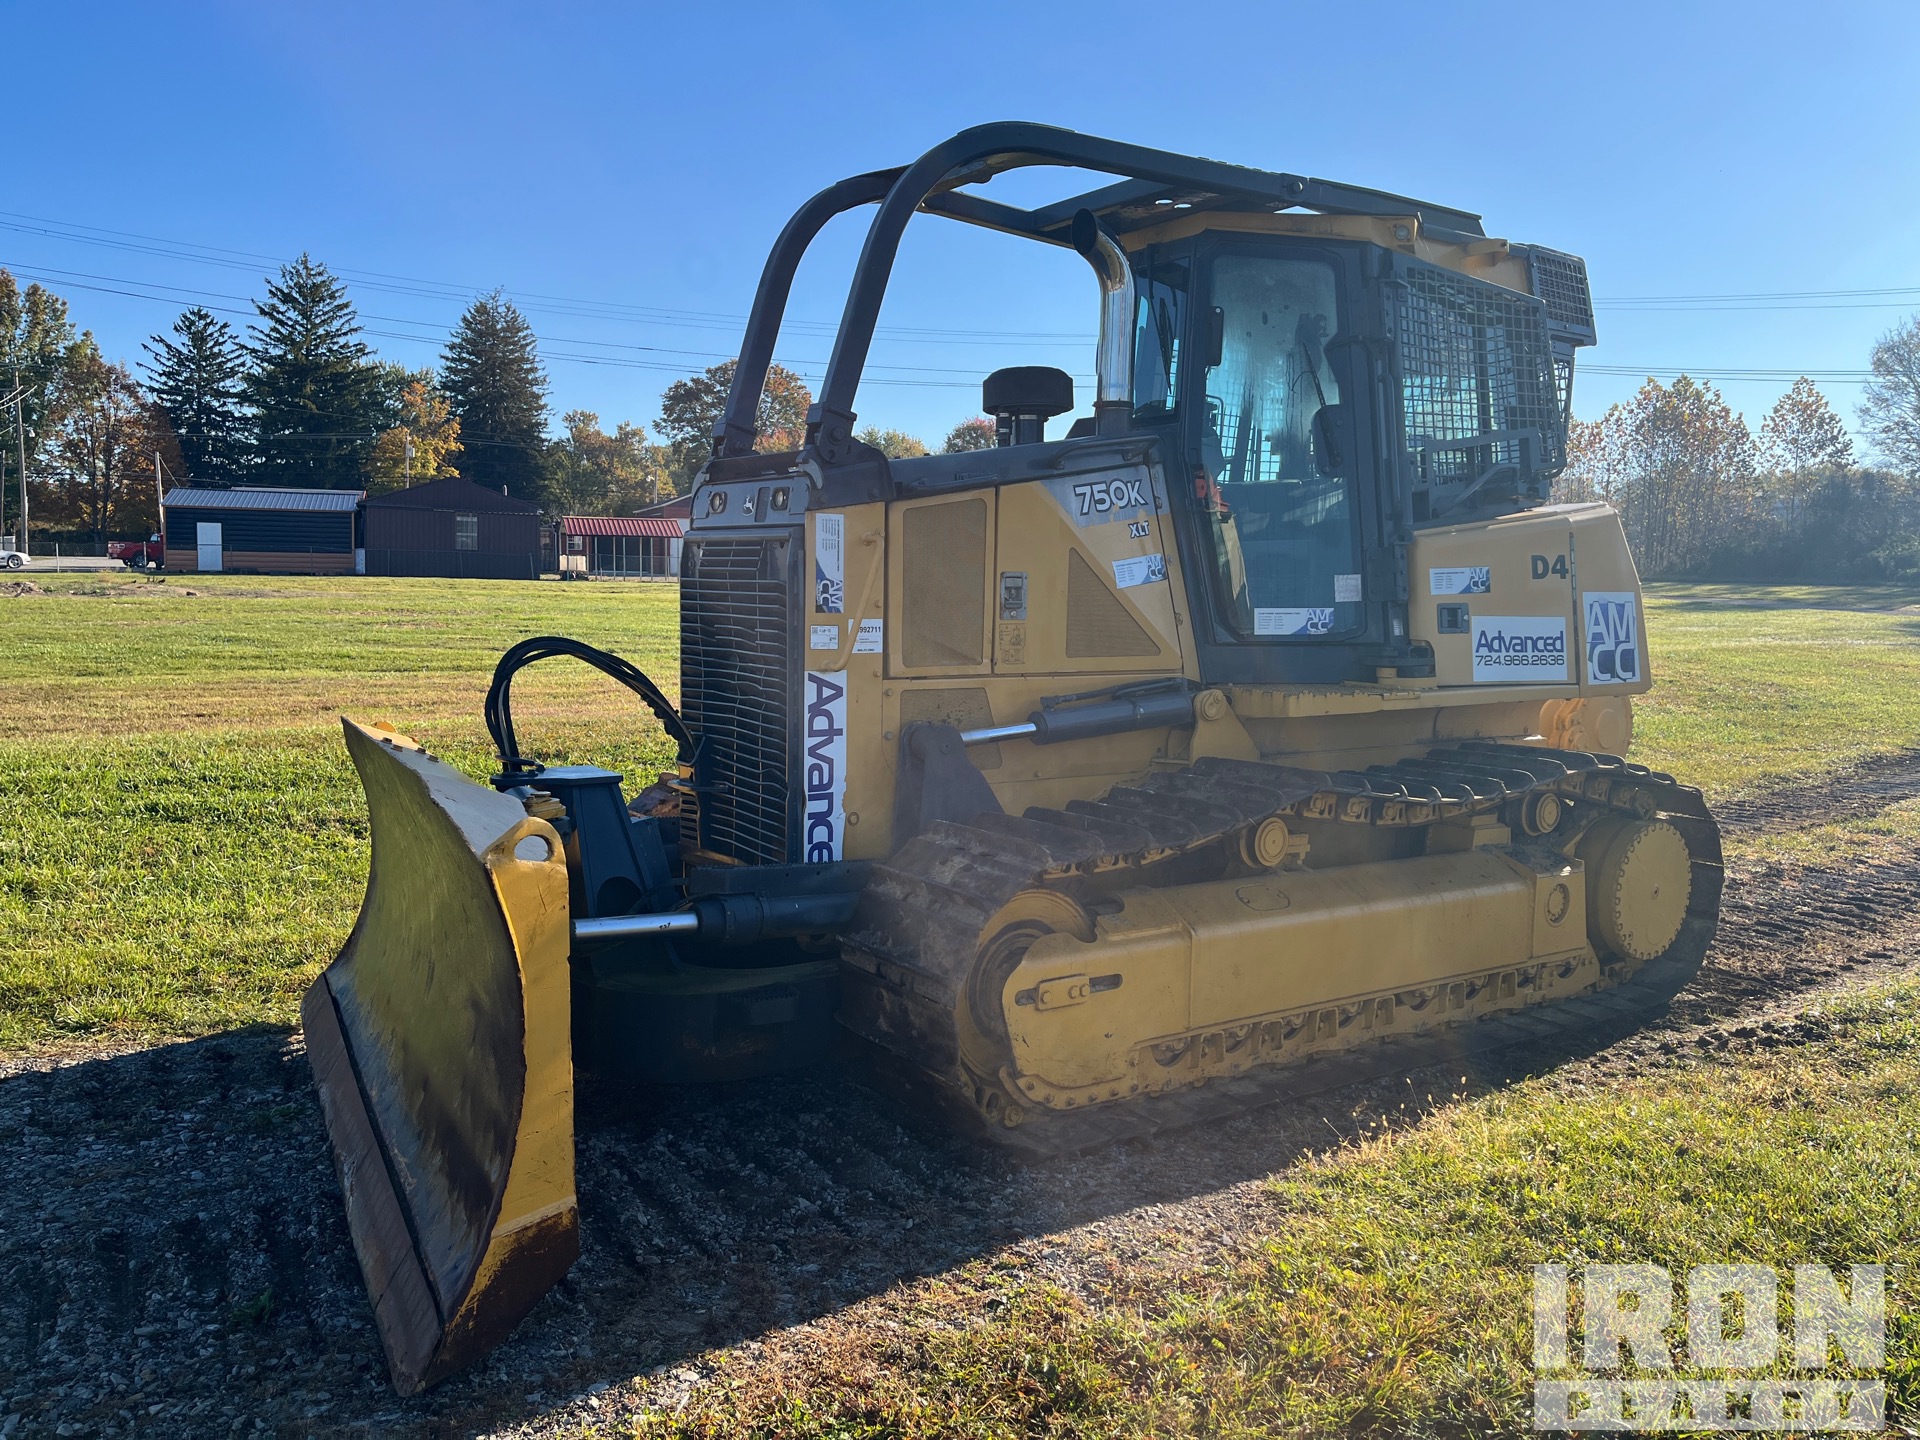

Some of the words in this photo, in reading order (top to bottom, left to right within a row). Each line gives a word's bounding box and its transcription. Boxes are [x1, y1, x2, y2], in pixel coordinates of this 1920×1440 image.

[1073, 478, 1148, 516] 750K
[1128, 521, 1150, 539] XLT
[1531, 554, 1569, 580] D4
[1475, 630, 1564, 654] Advanced
[1475, 655, 1565, 666] 724.966.2636
